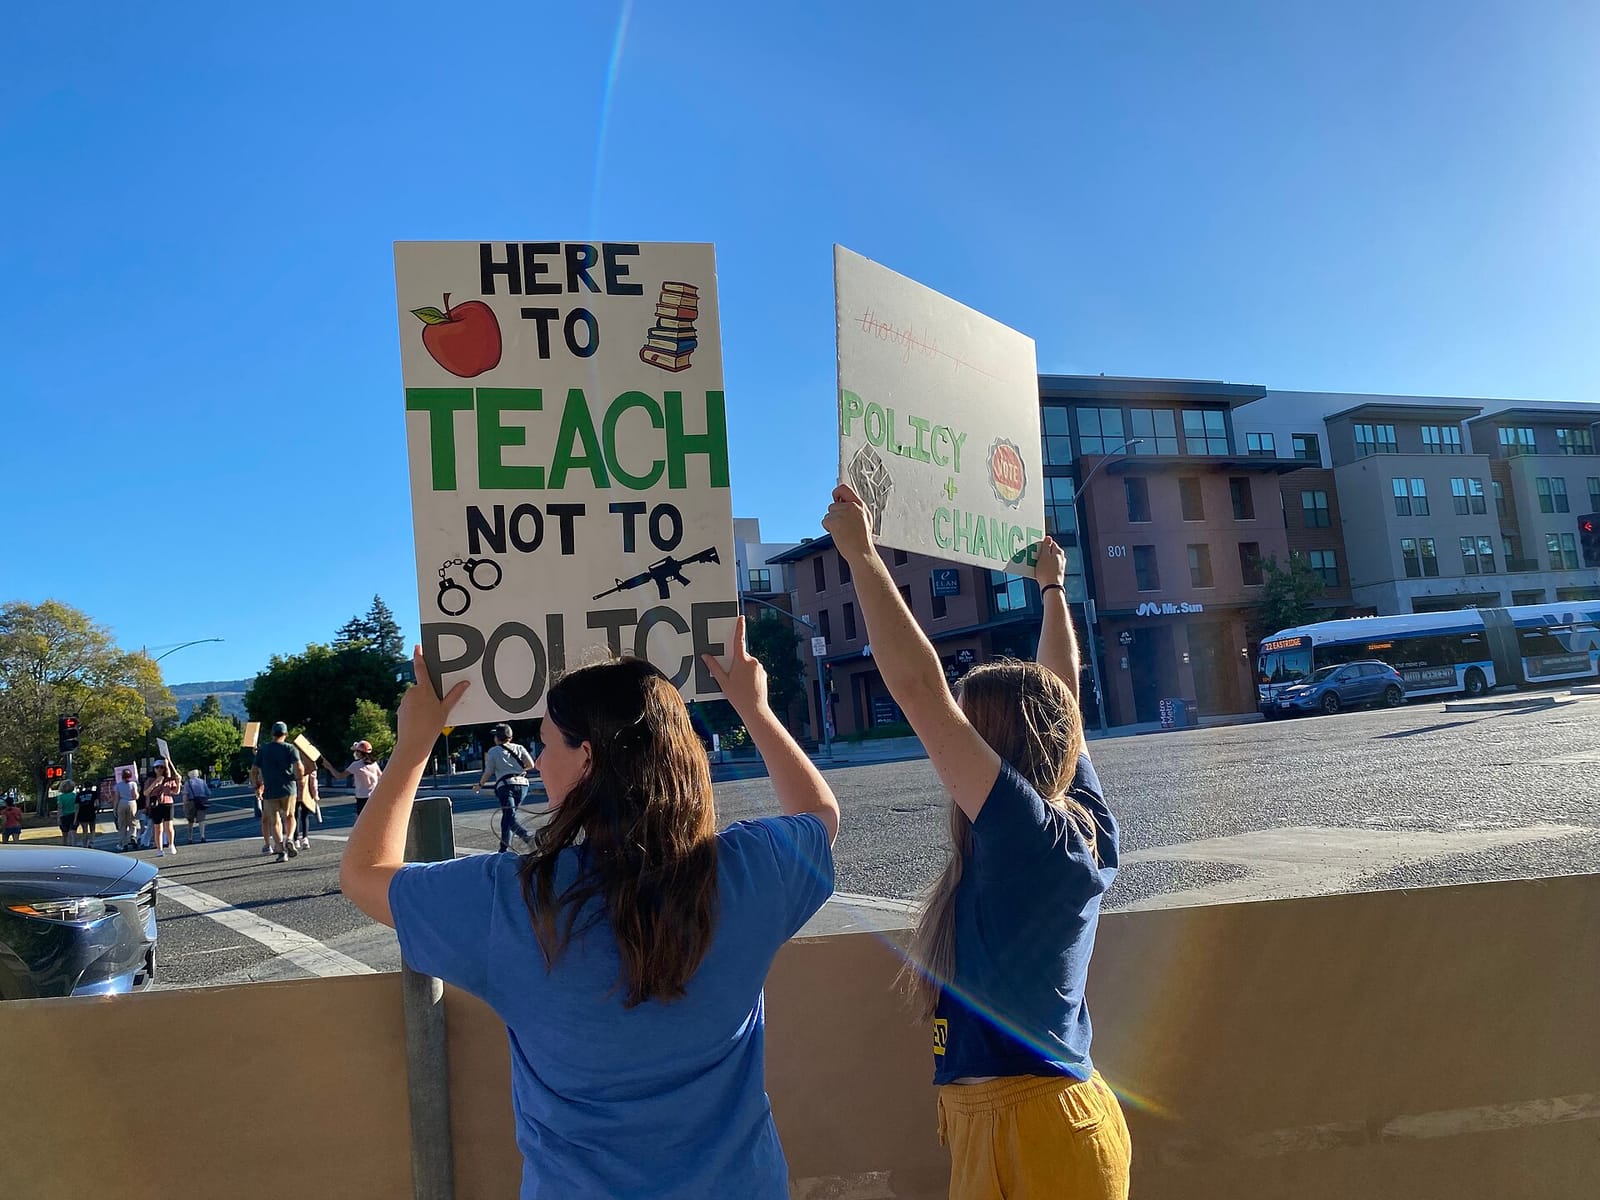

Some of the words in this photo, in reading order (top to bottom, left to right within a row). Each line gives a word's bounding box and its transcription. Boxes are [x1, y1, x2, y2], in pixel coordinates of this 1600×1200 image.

[480, 243, 643, 296] HERE
[521, 307, 599, 359] TO
[405, 387, 730, 490] TEACH
[841, 389, 967, 473] POLICY
[466, 504, 585, 555] NOT
[609, 502, 683, 553] TO
[933, 506, 1045, 567] CHANGE
[1107, 546, 1126, 558] 801
[1162, 603, 1180, 614] Mr.
[1181, 602, 1203, 613] Sun
[1273, 638, 1302, 649] EASTRIDGE
